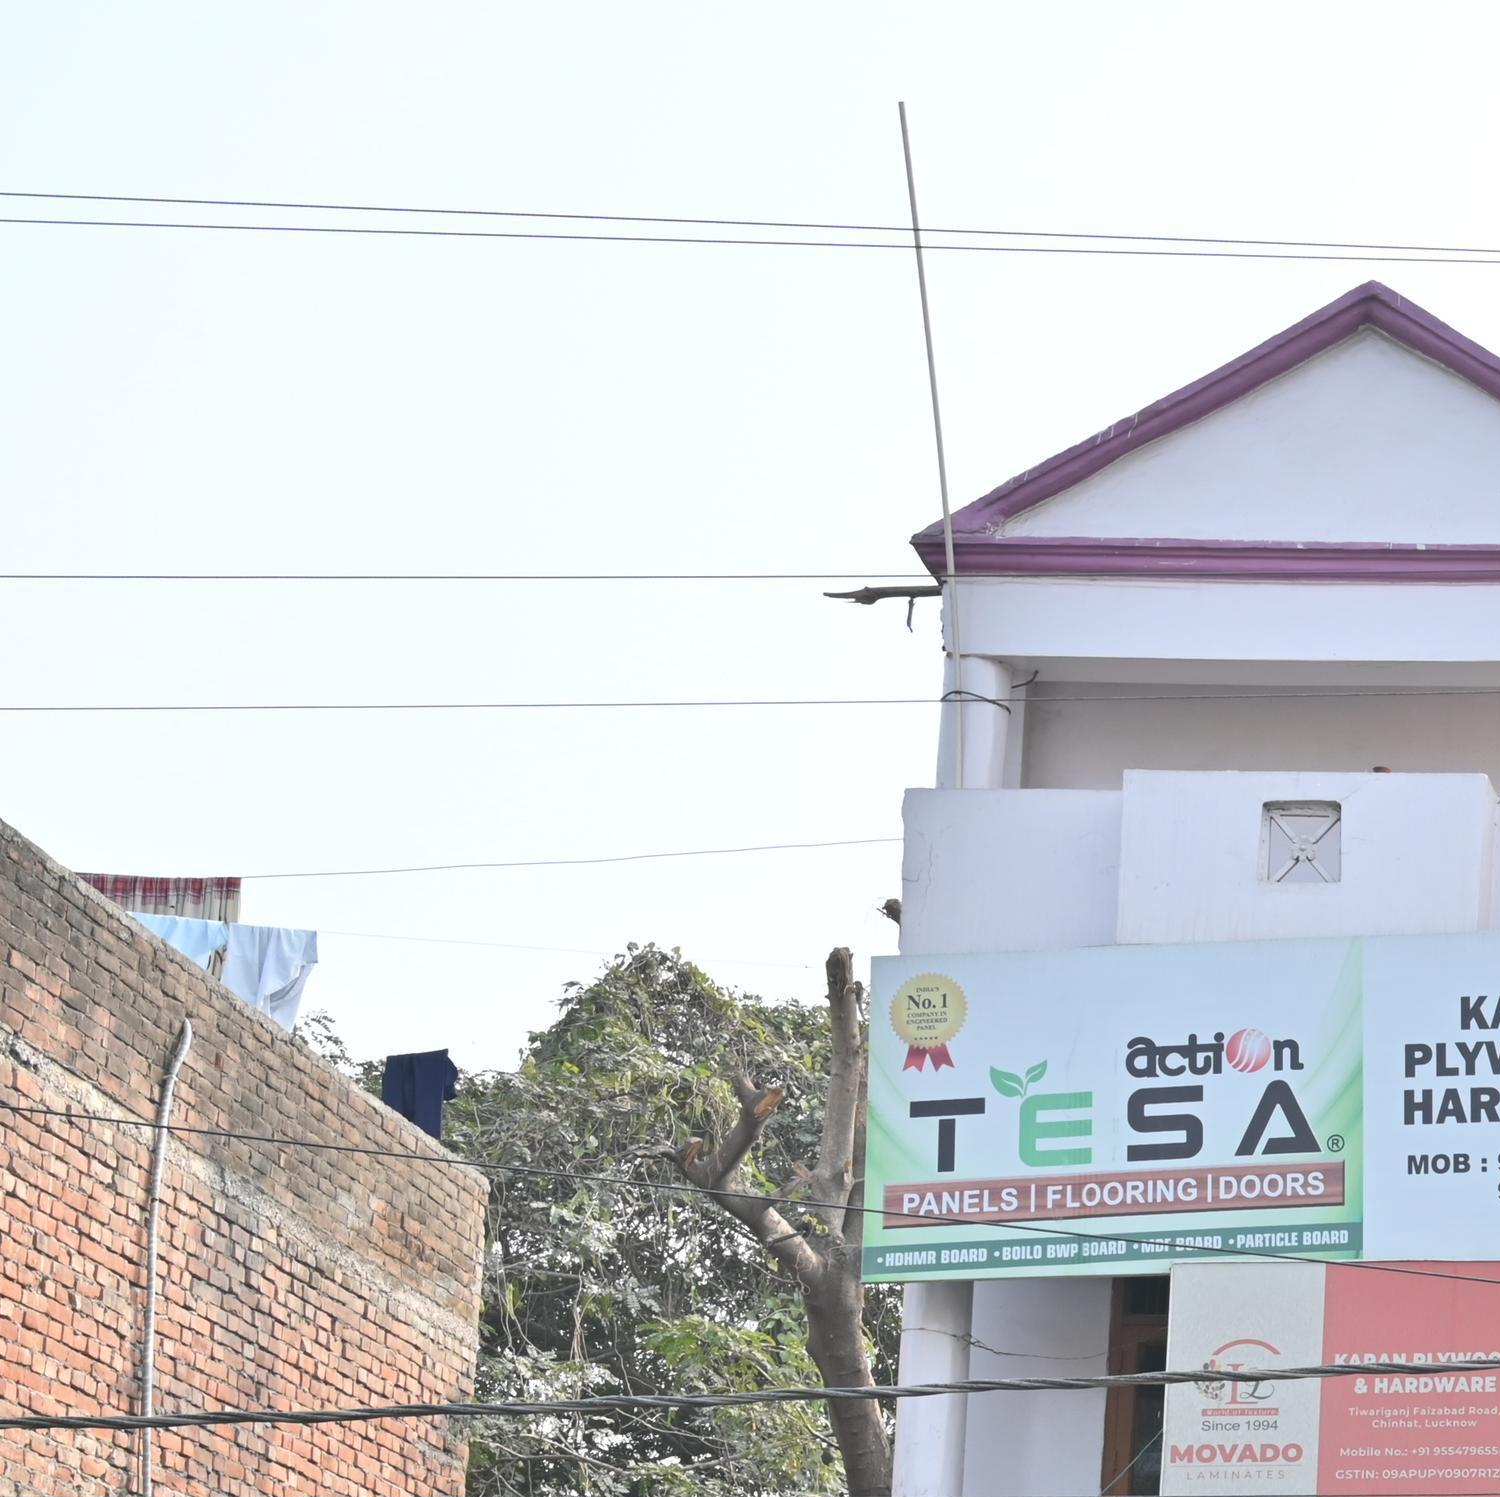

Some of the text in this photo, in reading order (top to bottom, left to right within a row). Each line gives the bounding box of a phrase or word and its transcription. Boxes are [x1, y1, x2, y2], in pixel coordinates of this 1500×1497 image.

[907, 993, 948, 1010] No. 1
[1407, 1153, 1469, 1176] MOB
[903, 1172, 1325, 1215] PANELS FLOORING DOORS
[941, 1248, 987, 1264] BOARD
[1046, 1243, 1078, 1258] BWP
[1082, 1240, 1126, 1256] BOARD
[1303, 1230, 1348, 1245] BOARD
[1355, 1377, 1496, 1394] & HARDWARE
[1349, 1407, 1410, 1418] Tiwariganj
[1413, 1406, 1464, 1416] Faizabad
[1202, 1419, 1278, 1431] Since 1994
[1372, 1418, 1477, 1429] Chinhat, Lucknow
[1170, 1443, 1303, 1464] MOVADO
[1340, 1446, 1377, 1457] Mobile
[1382, 1446, 1407, 1457] No.:
[1411, 1446, 1429, 1456] +91
[1187, 1469, 1285, 1480] LAMINATES
[1336, 1469, 1379, 1479] GSTIN:
